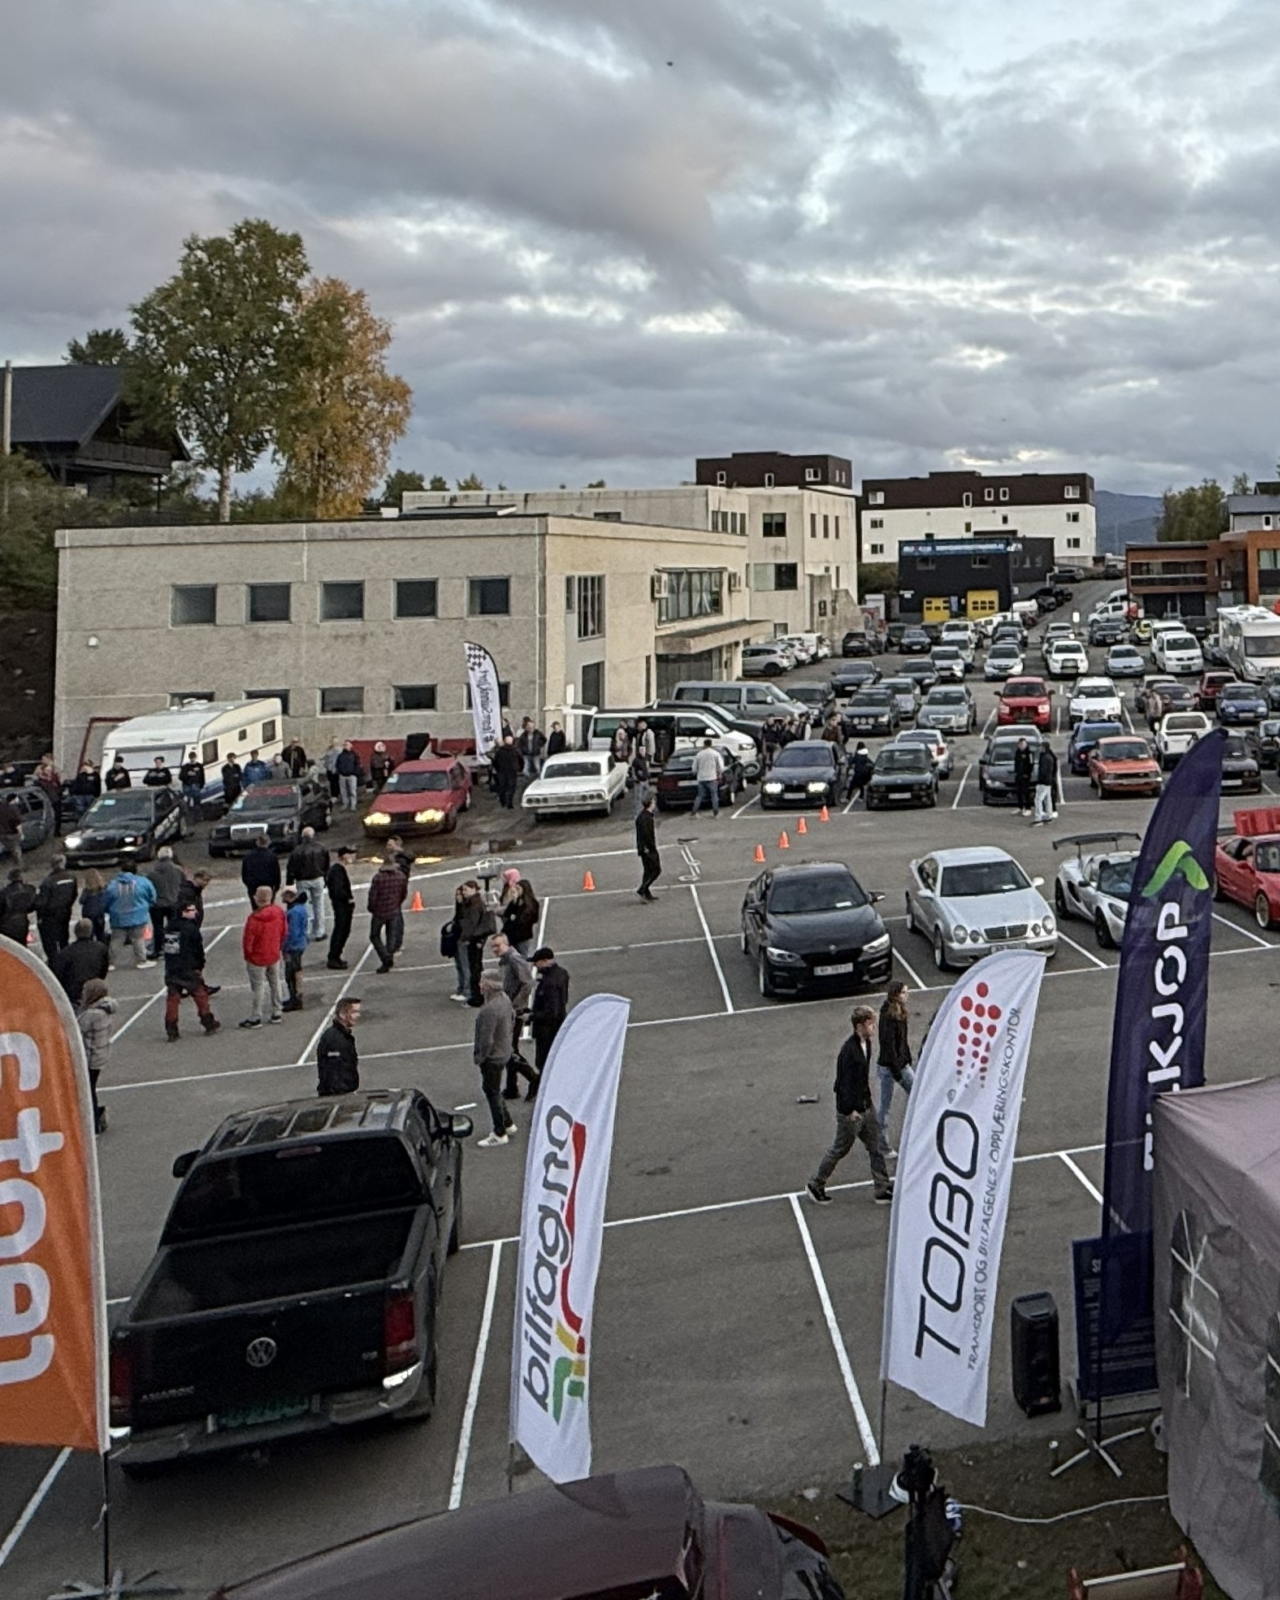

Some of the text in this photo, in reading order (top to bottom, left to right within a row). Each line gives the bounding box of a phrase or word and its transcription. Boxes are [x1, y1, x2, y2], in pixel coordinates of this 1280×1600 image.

[1144, 901, 1189, 1171] KJØP
[523, 1104, 575, 1414] bilfag.no
[914, 1109, 980, 1359] TOBO
[967, 1286, 989, 1371] TRANSPORT
[974, 1259, 989, 1284] OG
